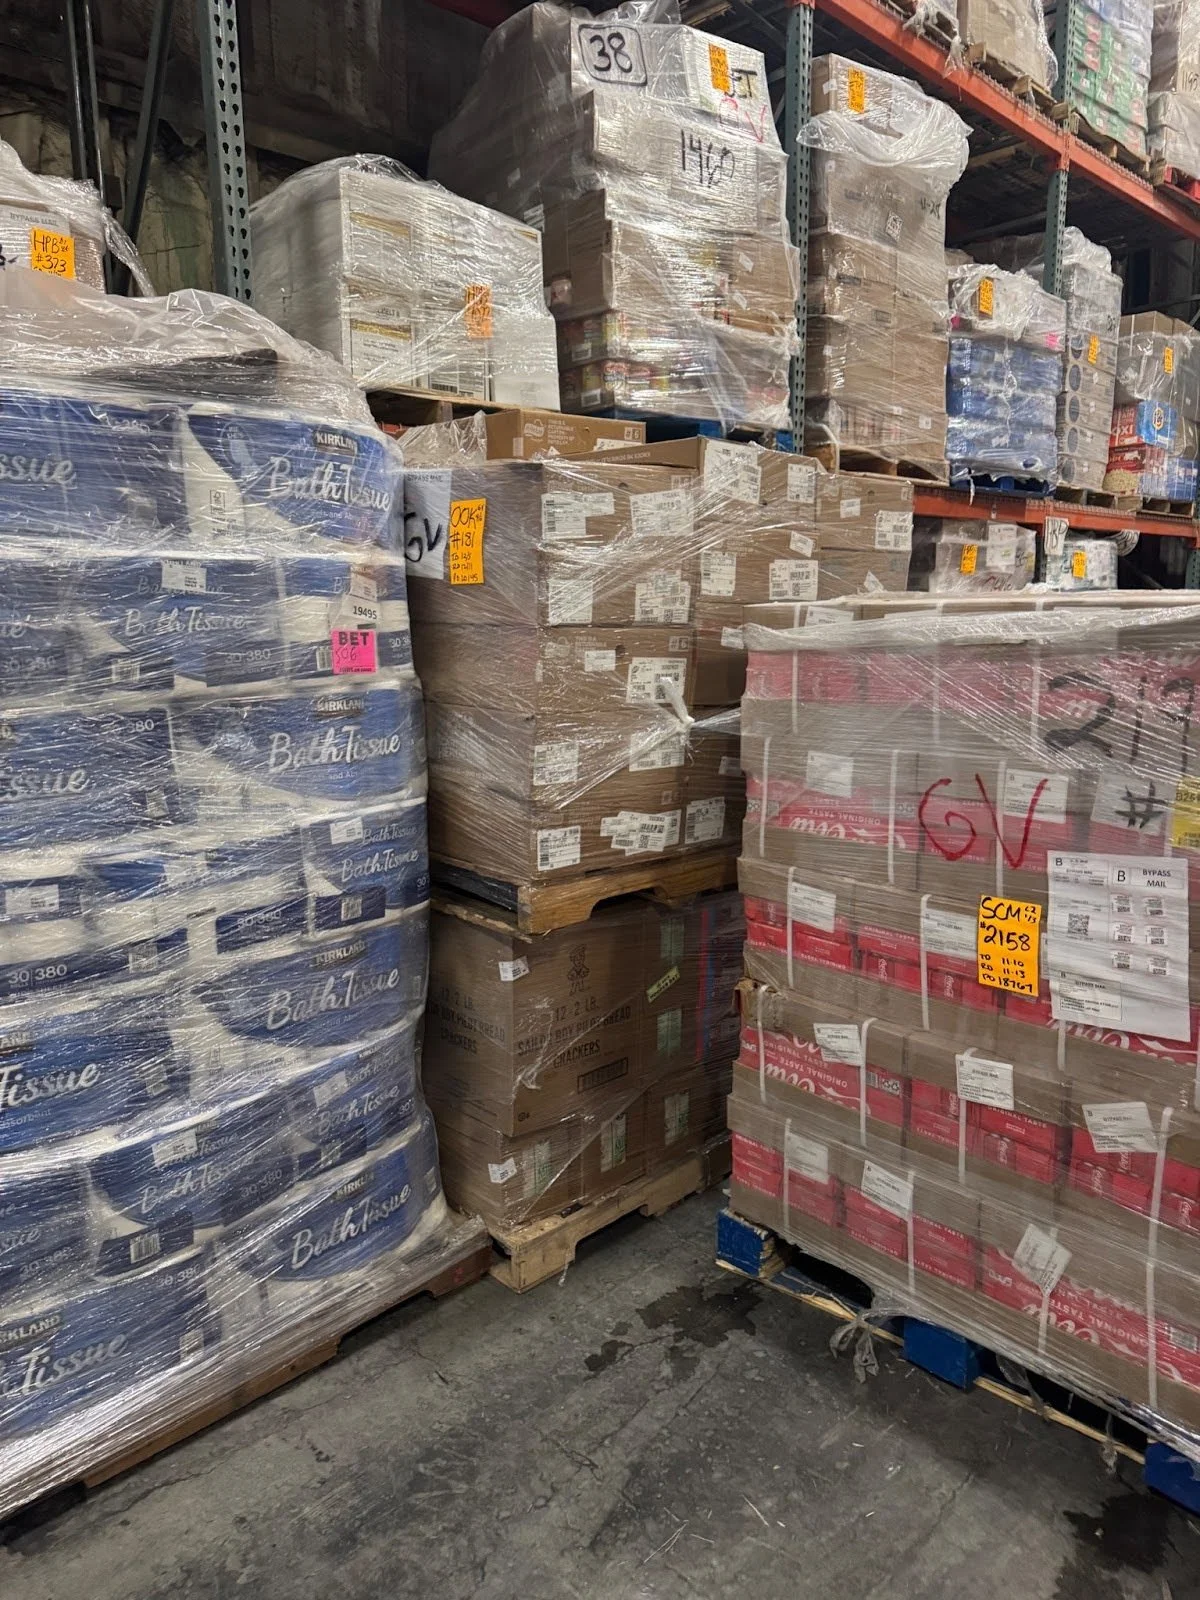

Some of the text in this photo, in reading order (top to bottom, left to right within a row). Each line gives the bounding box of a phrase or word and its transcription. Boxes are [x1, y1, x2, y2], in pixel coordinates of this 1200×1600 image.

[590, 32, 632, 73] 38
[33, 230, 60, 254] HPB
[36, 252, 67, 273] #373
[269, 456, 341, 500] Bath
[451, 506, 478, 529] OOK
[353, 605, 377, 620] 19495
[338, 631, 370, 646] BET
[268, 725, 401, 774] Bath Tissue
[838, 812, 881, 826] ORIGINAL
[363, 824, 392, 845] Bath
[341, 848, 420, 883] Bath Tissue
[1055, 857, 1063, 866] B
[1117, 868, 1171, 882] B BYPASS
[1147, 879, 1166, 889] MAIL
[981, 896, 1021, 922] SCM
[980, 921, 1031, 952] #2158
[8, 964, 68, 985] 30 380
[266, 967, 400, 1030] Bath Tissue
[556, 1027, 573, 1041] BOY
[553, 1037, 602, 1069] CRACKERS
[779, 1056, 808, 1073] TASTE
[808, 1066, 849, 1089] ORIGINAL
[0, 1062, 101, 1112] Tissue
[1022, 1115, 1048, 1129] TASTE
[240, 1168, 283, 1197] 30 380
[291, 1184, 412, 1271] Bath Tissue
[1049, 1298, 1086, 1321] TASTE
[1089, 1314, 1150, 1349] ORIGINAL
[17, 1333, 129, 1396] Tissue
